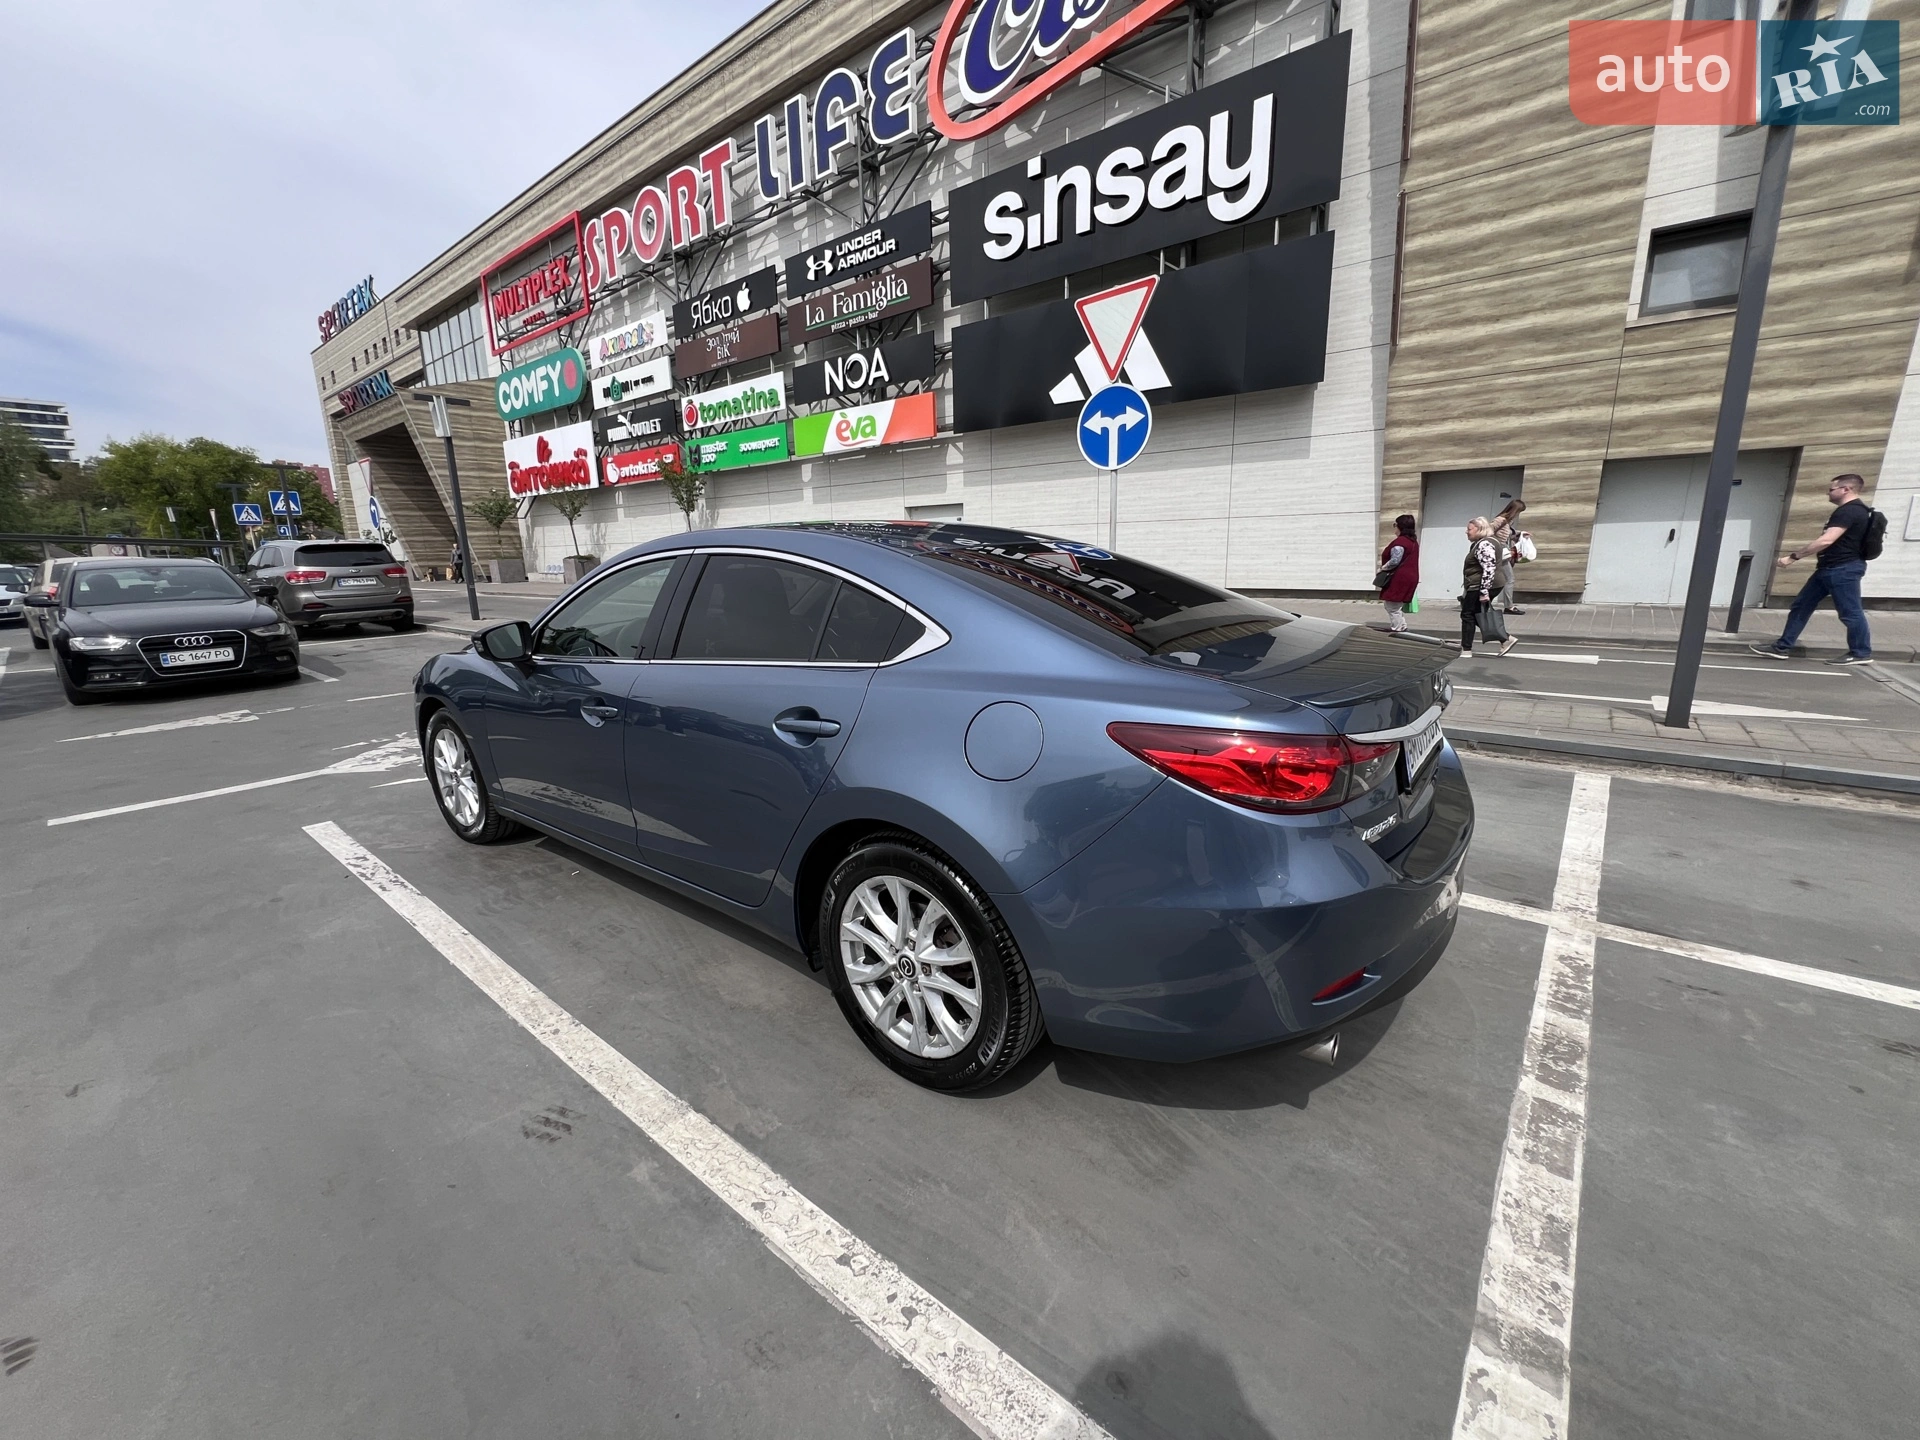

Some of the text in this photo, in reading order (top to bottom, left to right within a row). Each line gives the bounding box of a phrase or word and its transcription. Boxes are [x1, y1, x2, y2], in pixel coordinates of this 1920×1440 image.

[584, 137, 738, 294] SPORT
[754, 27, 918, 202] LIFE
[983, 92, 1275, 260] sinsay
[836, 229, 881, 256] UNDER
[837, 238, 896, 271] ARMOUR
[493, 255, 572, 322] MULTIPLEX
[805, 274, 908, 327] La Famiglia
[691, 293, 732, 329] Ябко
[868, 311, 879, 320] bar
[498, 360, 562, 414] COMFY
[824, 347, 890, 395] NOA
[698, 386, 780, 423] tomatina
[631, 418, 661, 437] OUTLET
[700, 440, 728, 454] master
[701, 453, 716, 463] zoo
[169, 649, 231, 663] BC 1647 PO
